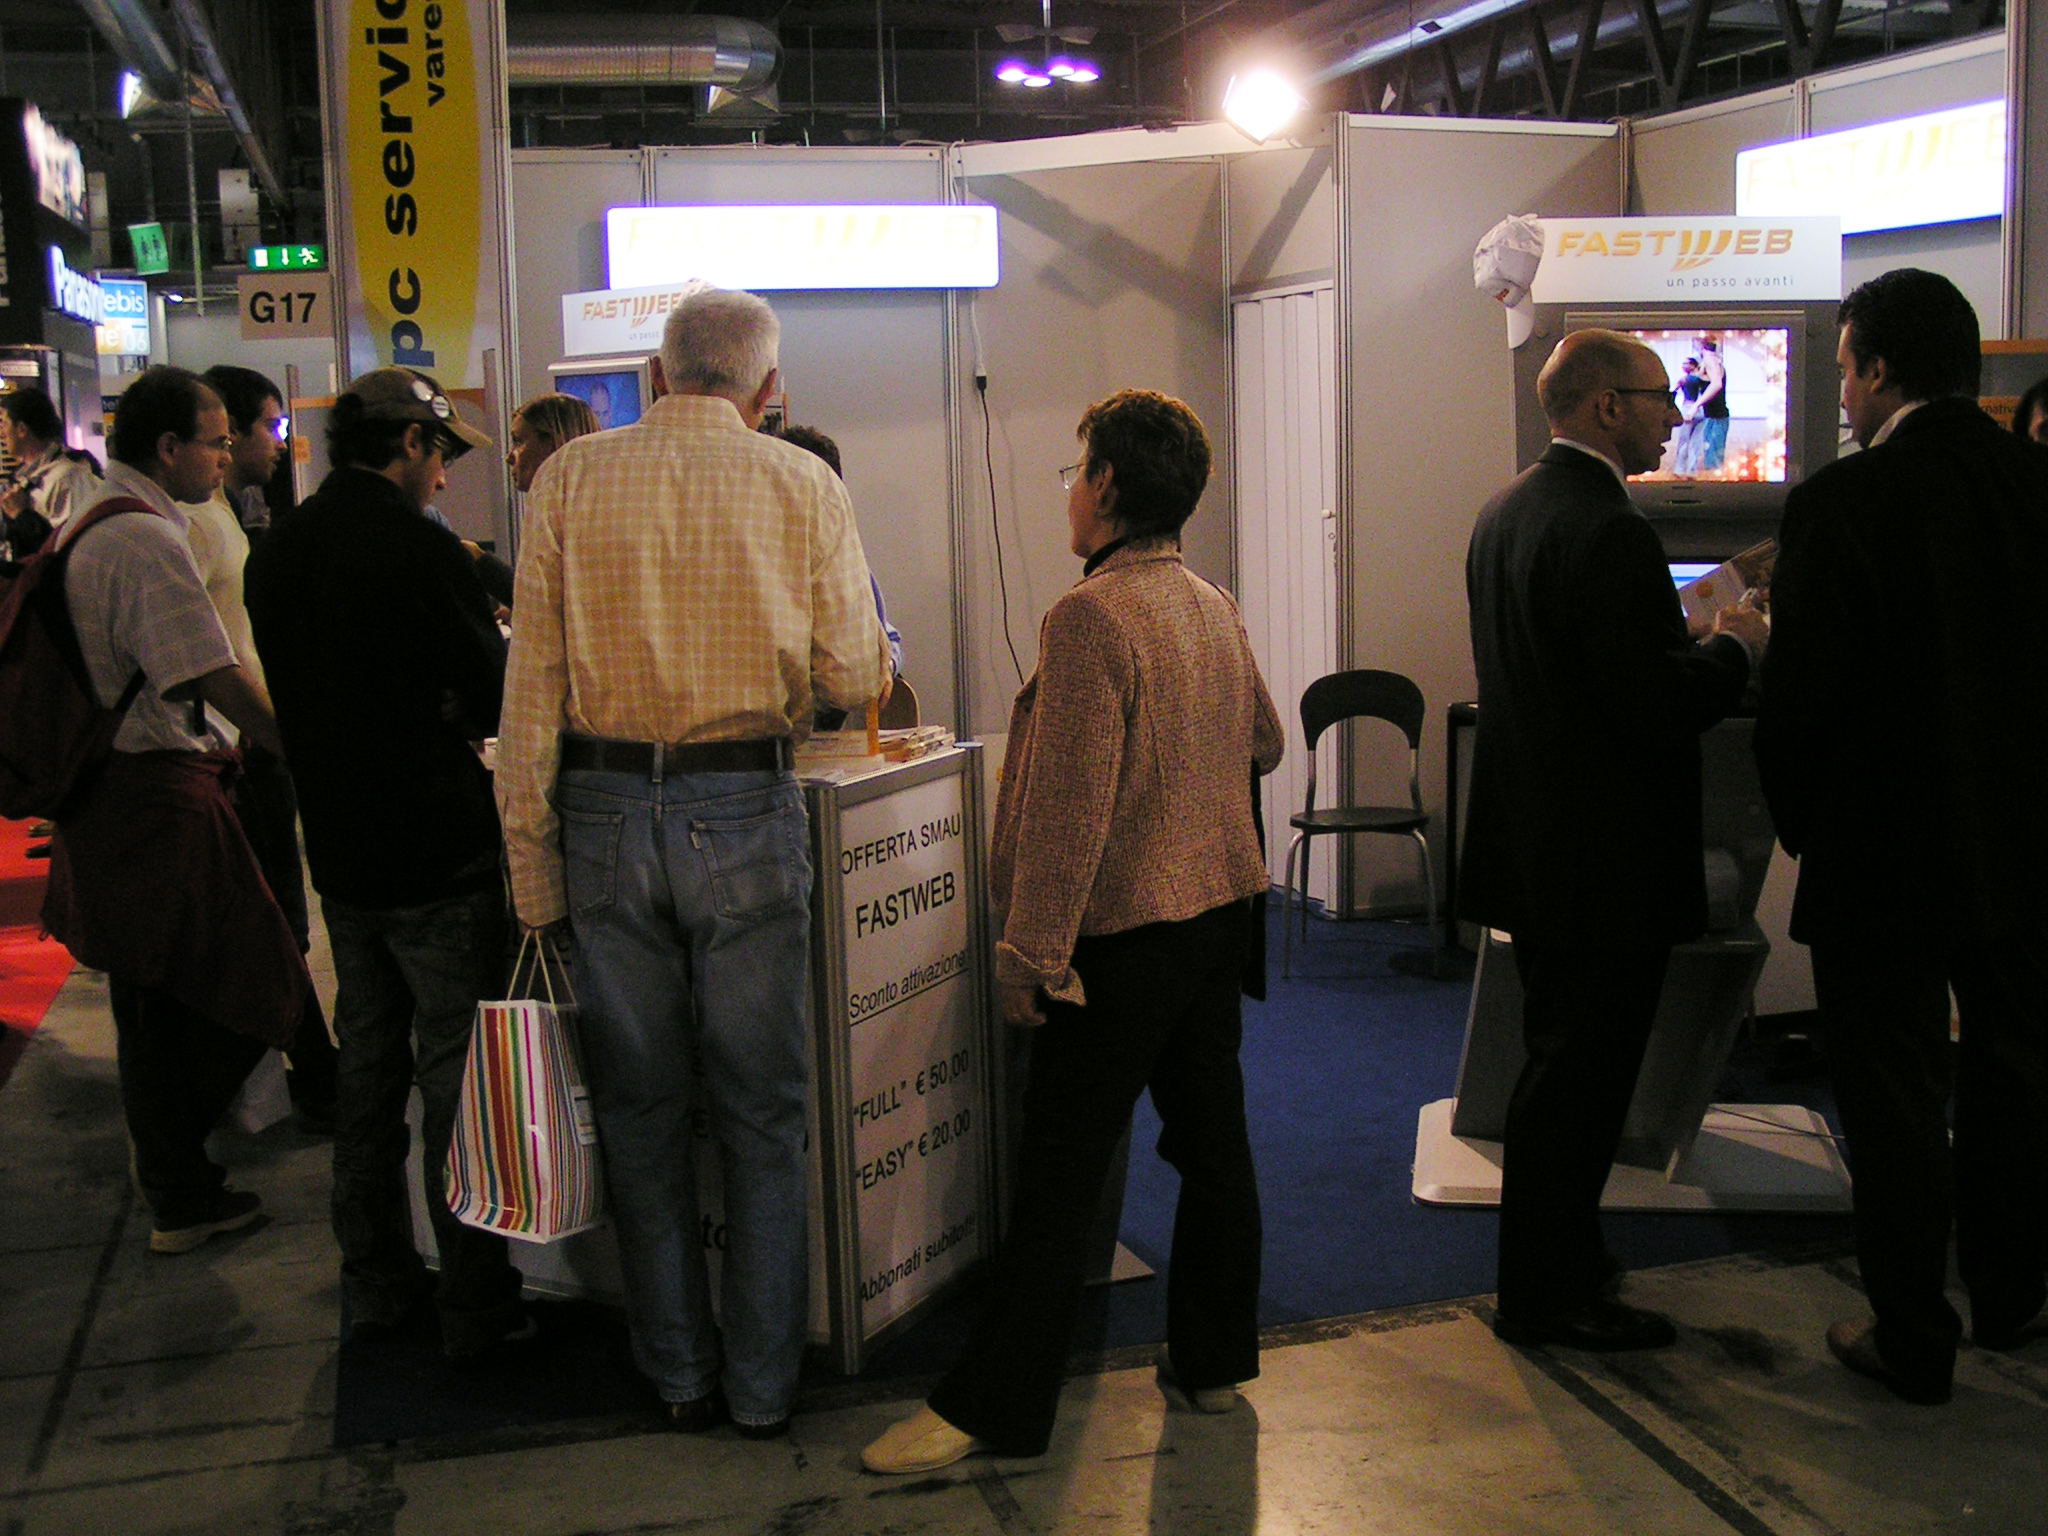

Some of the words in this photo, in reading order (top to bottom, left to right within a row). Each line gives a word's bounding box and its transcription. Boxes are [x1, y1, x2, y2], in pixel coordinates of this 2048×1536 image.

[424, 0, 447, 107] vare
[1556, 229, 1794, 272] FASTWEB
[250, 291, 317, 323] G17
[1667, 278, 1684, 287] un
[1692, 277, 1737, 288] passo
[1744, 276, 1794, 287] avanti
[388, 267, 435, 368] pc
[842, 830, 917, 875] OFFERTA
[921, 813, 961, 847] SMAU
[856, 871, 956, 939] FASTWEB
[850, 981, 898, 1018] Sconto
[860, 1247, 921, 1302] Abbonati
